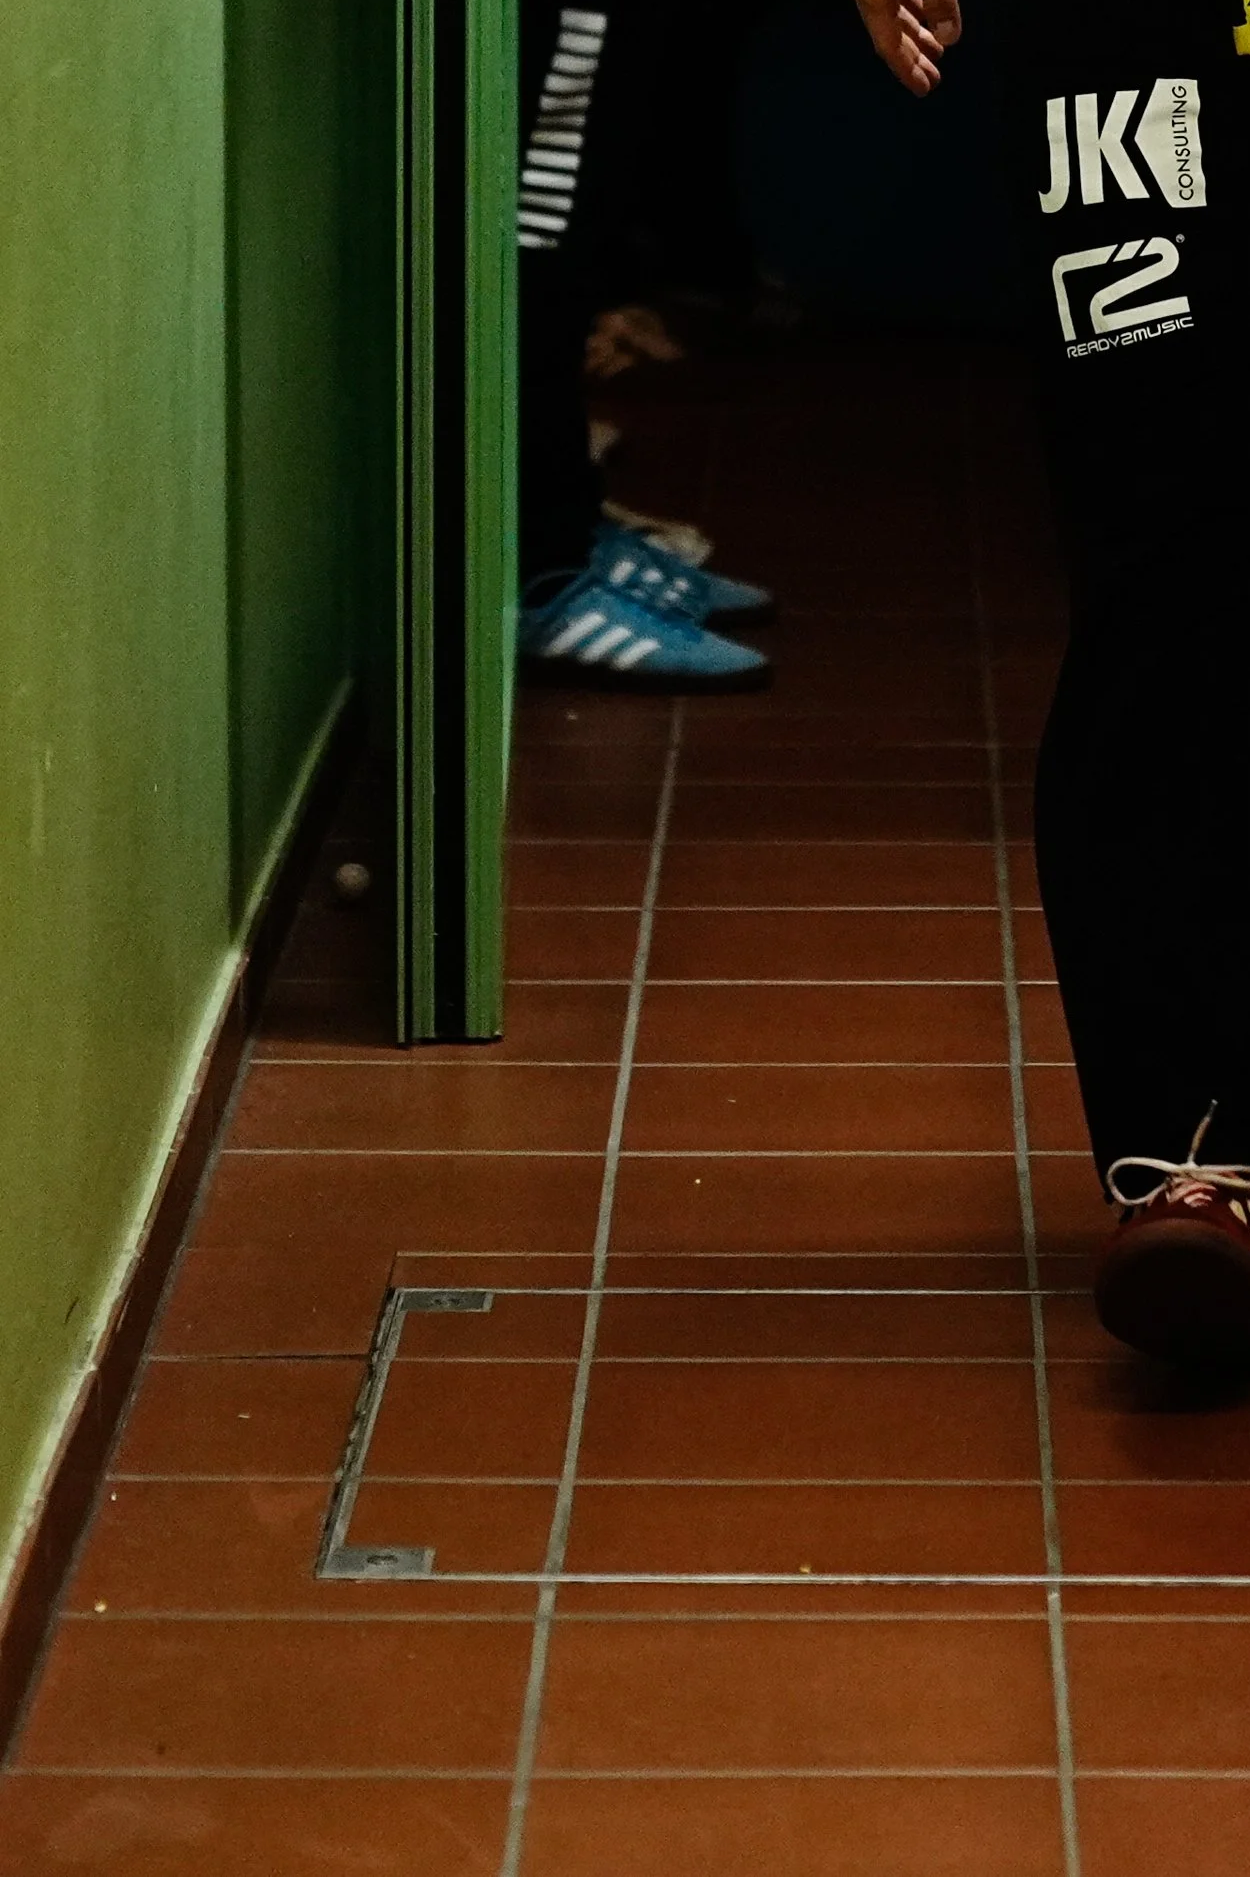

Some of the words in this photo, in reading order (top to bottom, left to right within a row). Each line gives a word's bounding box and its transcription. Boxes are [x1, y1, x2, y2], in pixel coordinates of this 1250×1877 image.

[1038, 89, 1151, 214] JK
[1171, 84, 1194, 201] CONSULTING
[1066, 316, 1195, 359] READY2MUSIC
